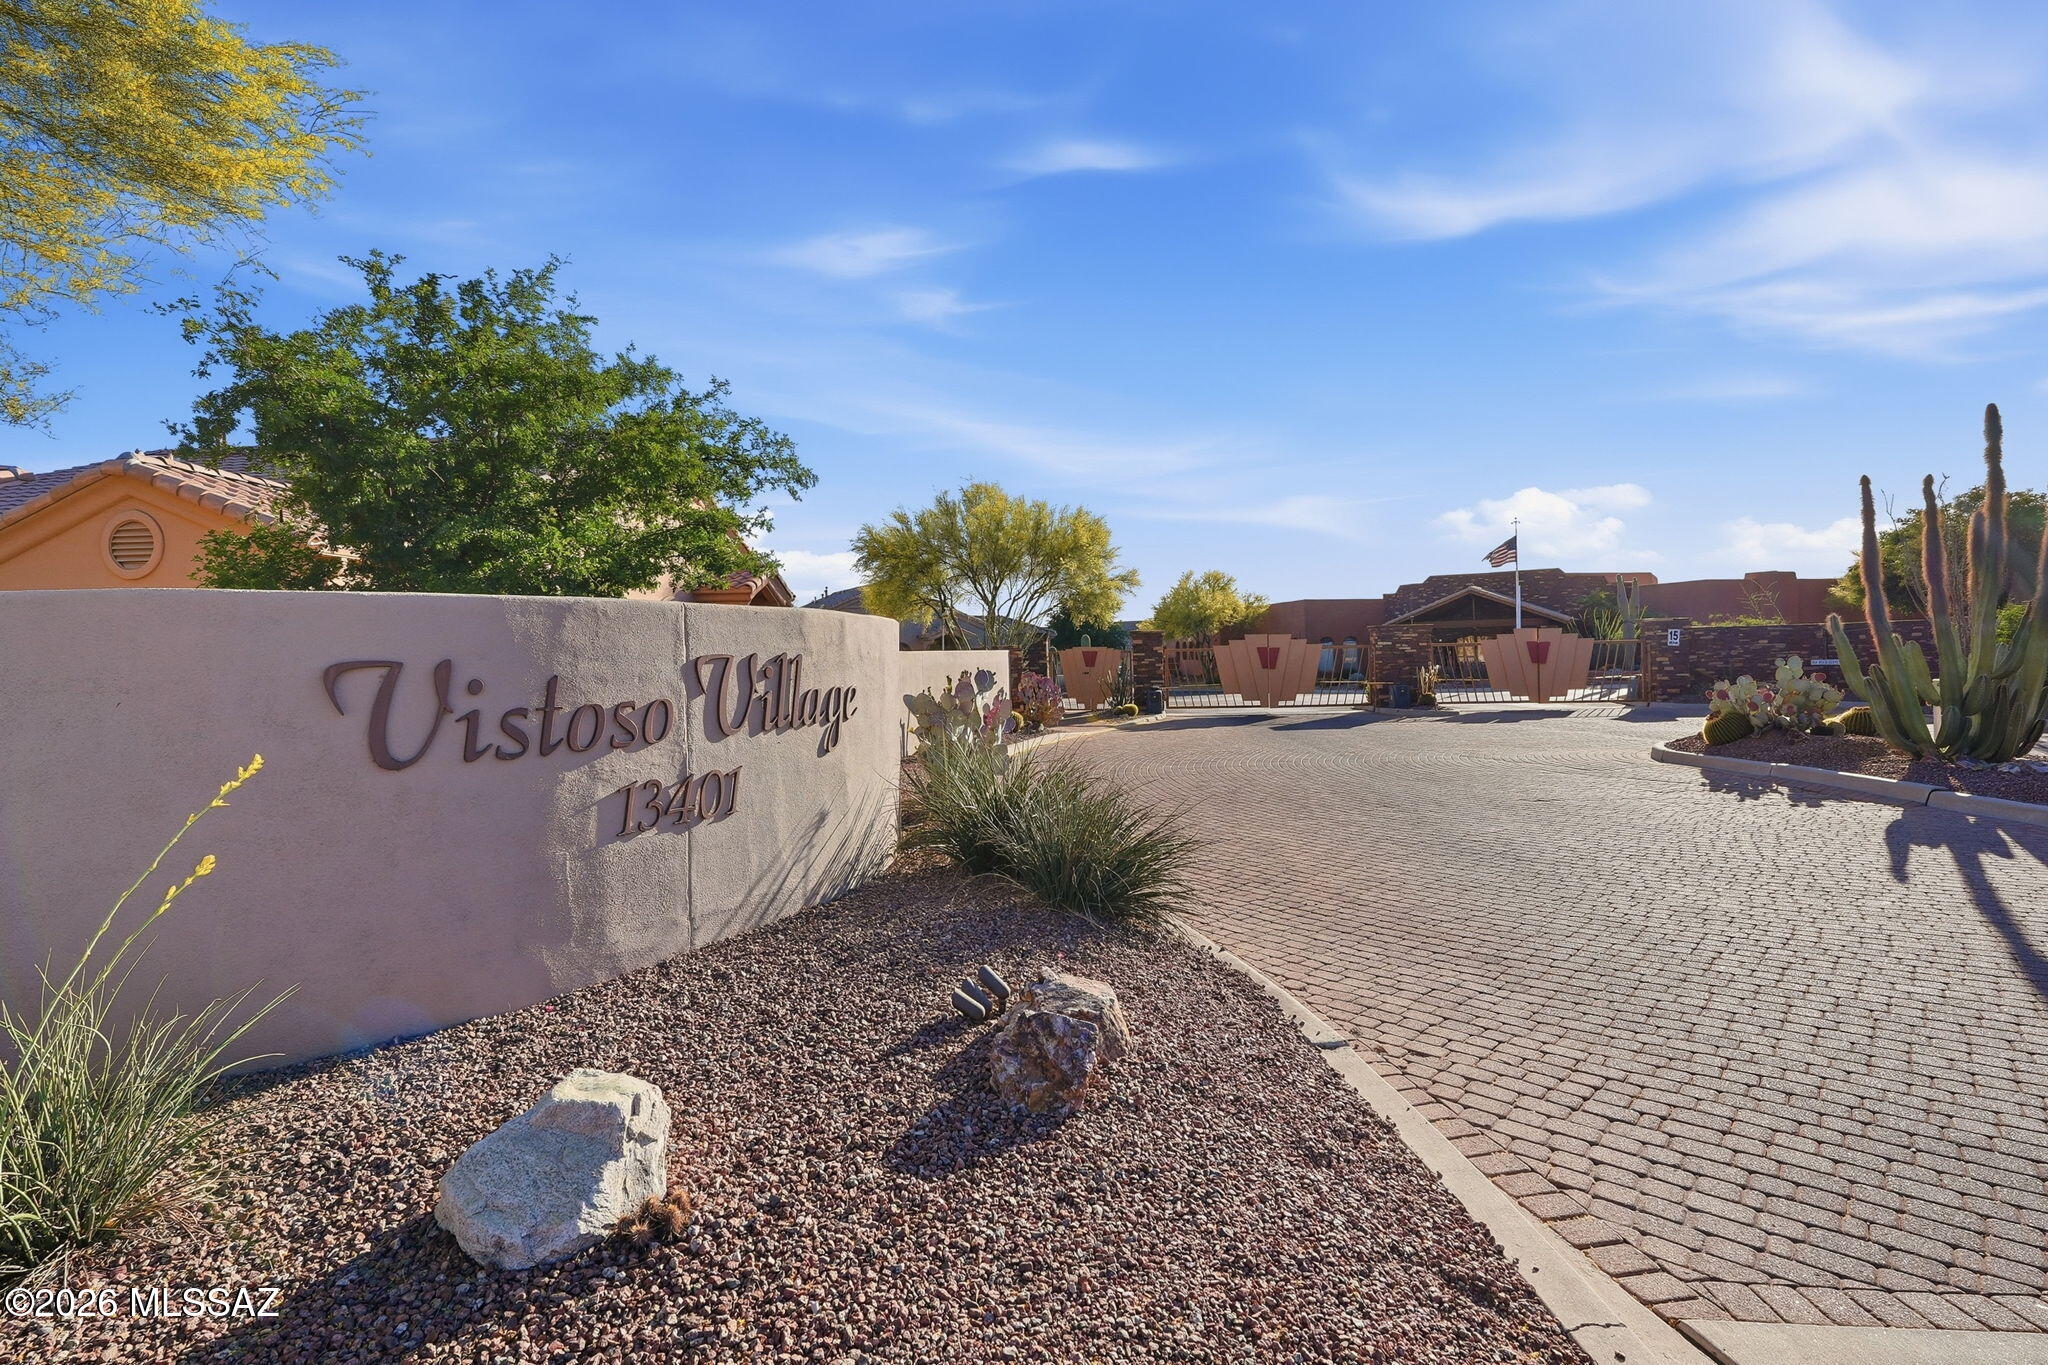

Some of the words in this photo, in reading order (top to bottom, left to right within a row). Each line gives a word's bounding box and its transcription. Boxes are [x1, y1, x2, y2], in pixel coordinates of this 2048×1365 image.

[1669, 630, 1679, 640] 15
[323, 657, 675, 771] Vistoso
[696, 651, 858, 753] Village
[616, 765, 743, 837] 13401
